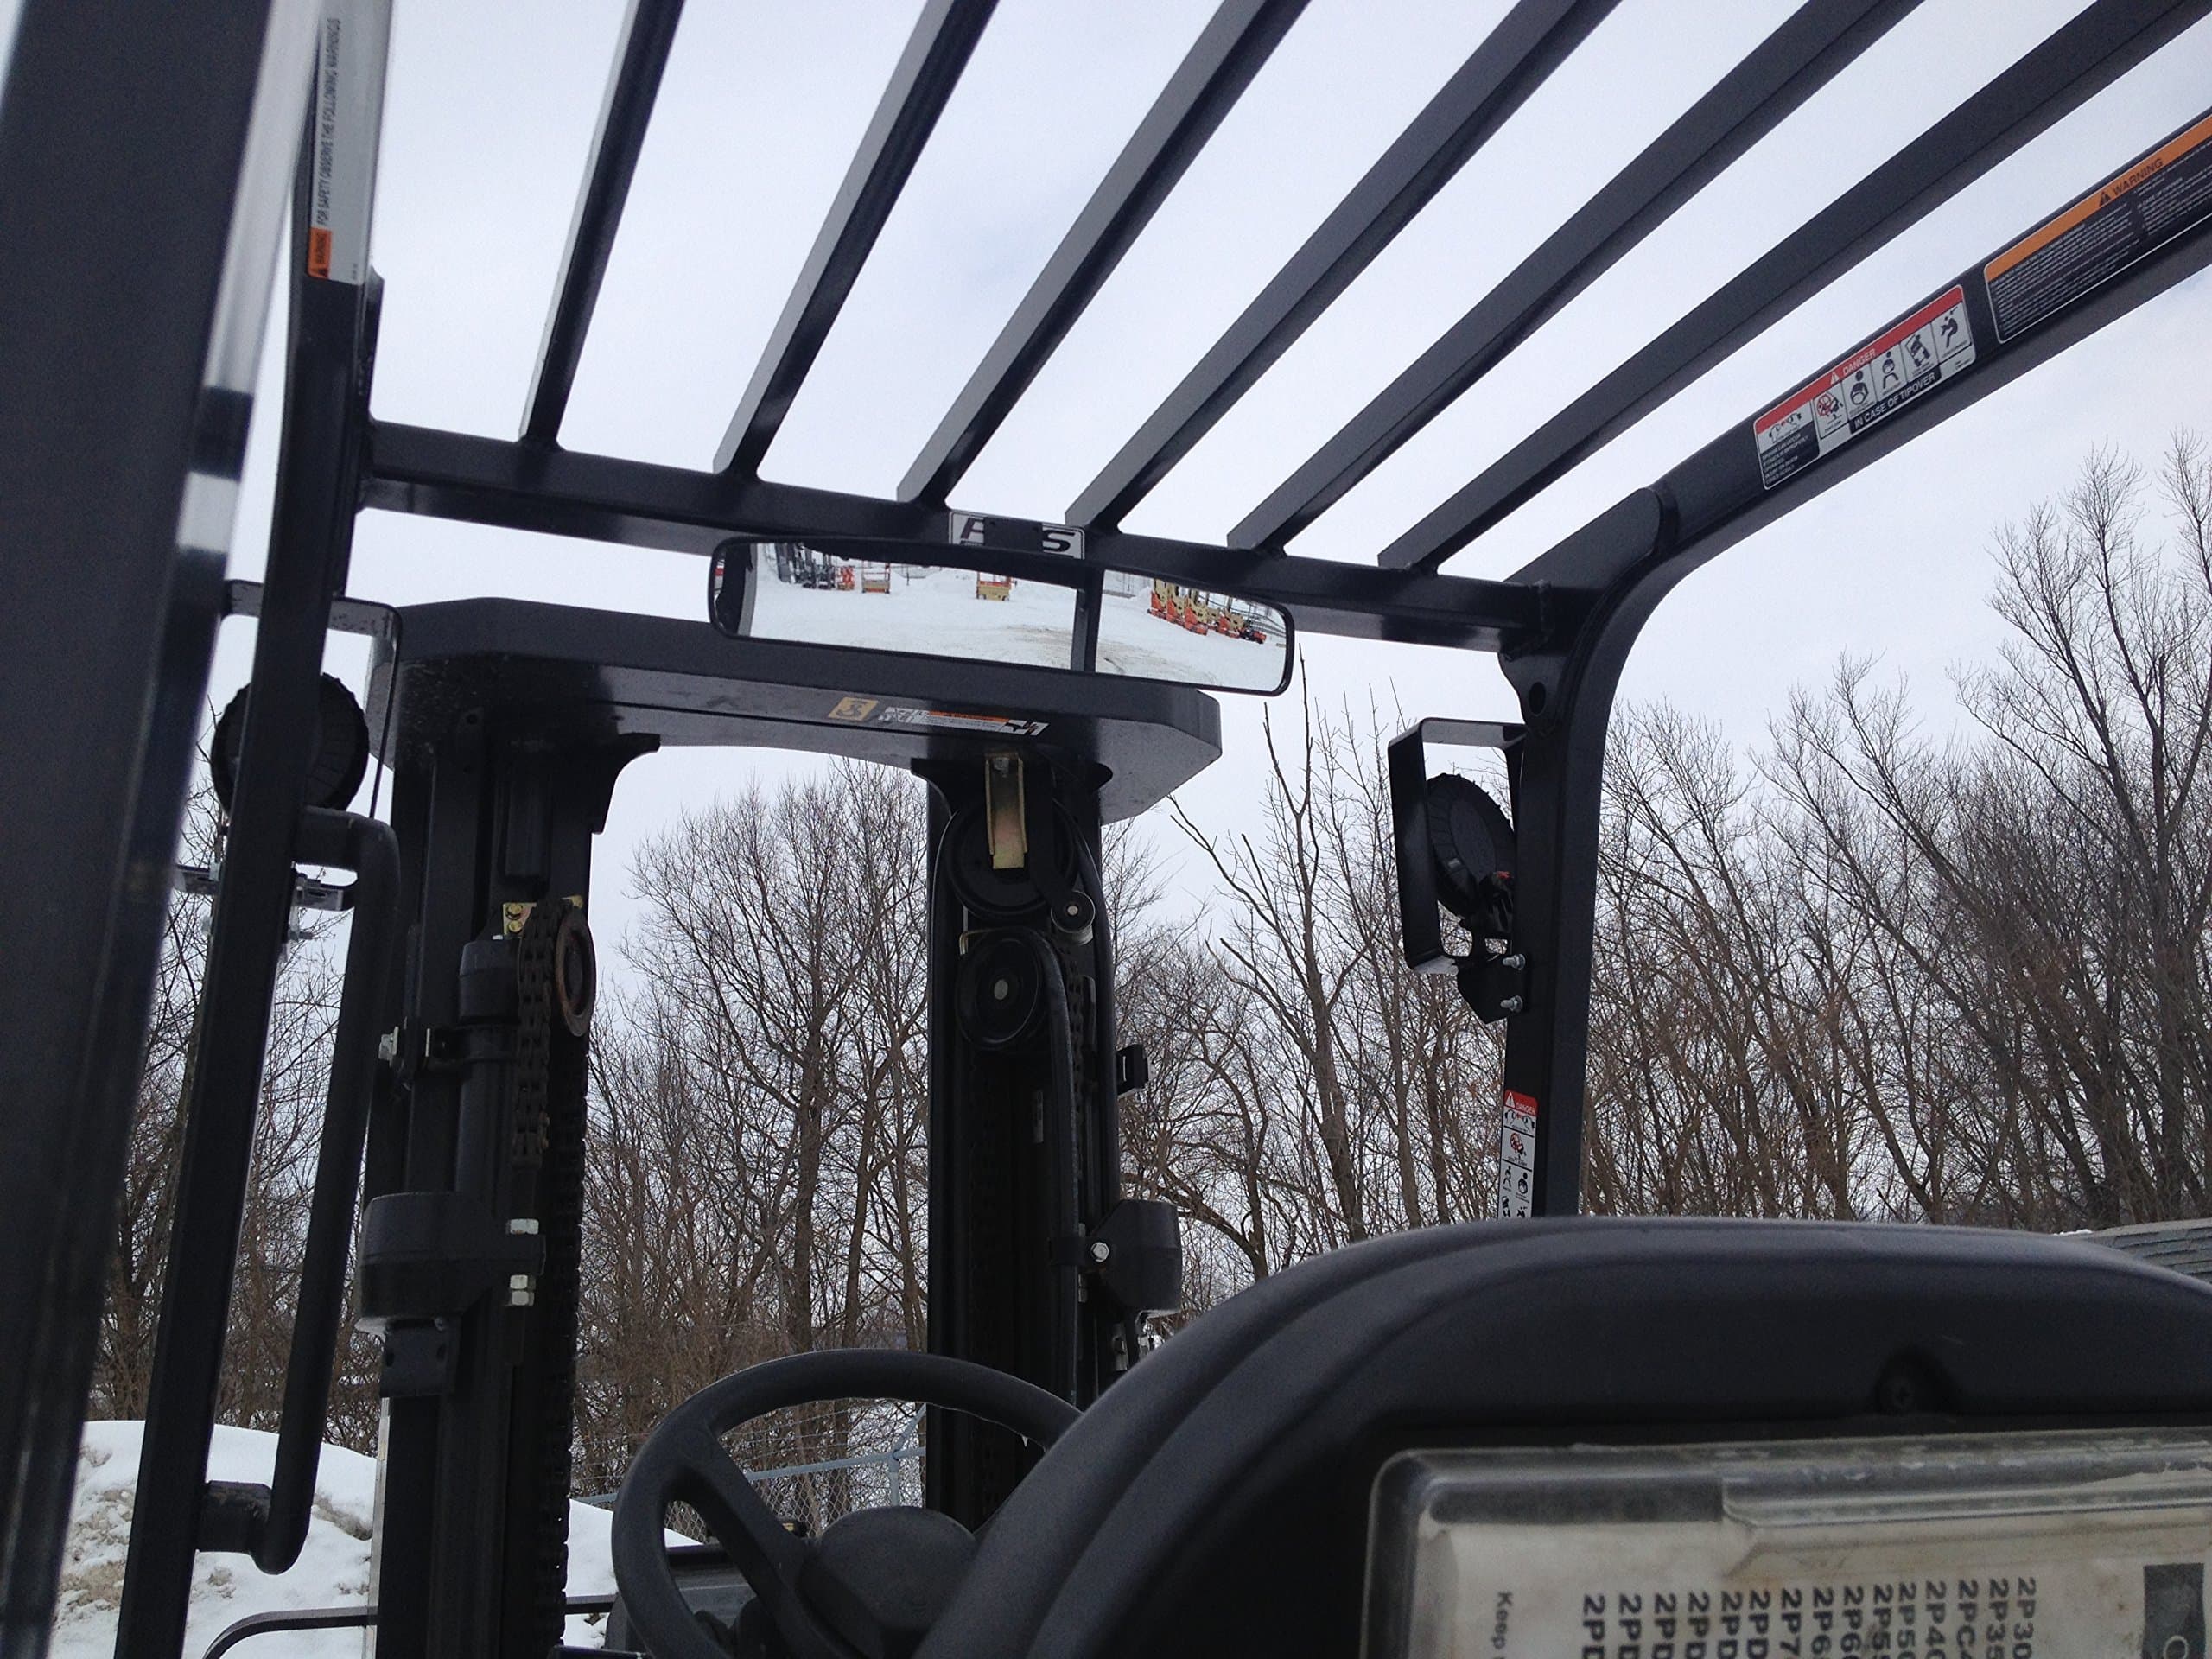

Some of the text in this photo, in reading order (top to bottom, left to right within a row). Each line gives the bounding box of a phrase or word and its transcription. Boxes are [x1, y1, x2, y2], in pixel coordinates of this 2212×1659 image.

[317, 178, 331, 208] SAFETY
[2113, 157, 2164, 196] WARNING
[316, 209, 329, 225] FOR
[1842, 347, 1877, 376] DANGER
[1853, 416, 1864, 429] IN
[1865, 402, 1887, 423] CASE
[1887, 394, 1901, 408] OF
[1900, 372, 1936, 401] TIPOVER
[1491, 1592, 1513, 1649] Keep
[1780, 1588, 1802, 1659] 2P7
[1811, 1586, 1834, 1659] 2P6
[1840, 1585, 1864, 1659] 2P6
[1872, 1584, 1894, 1659] 2P5
